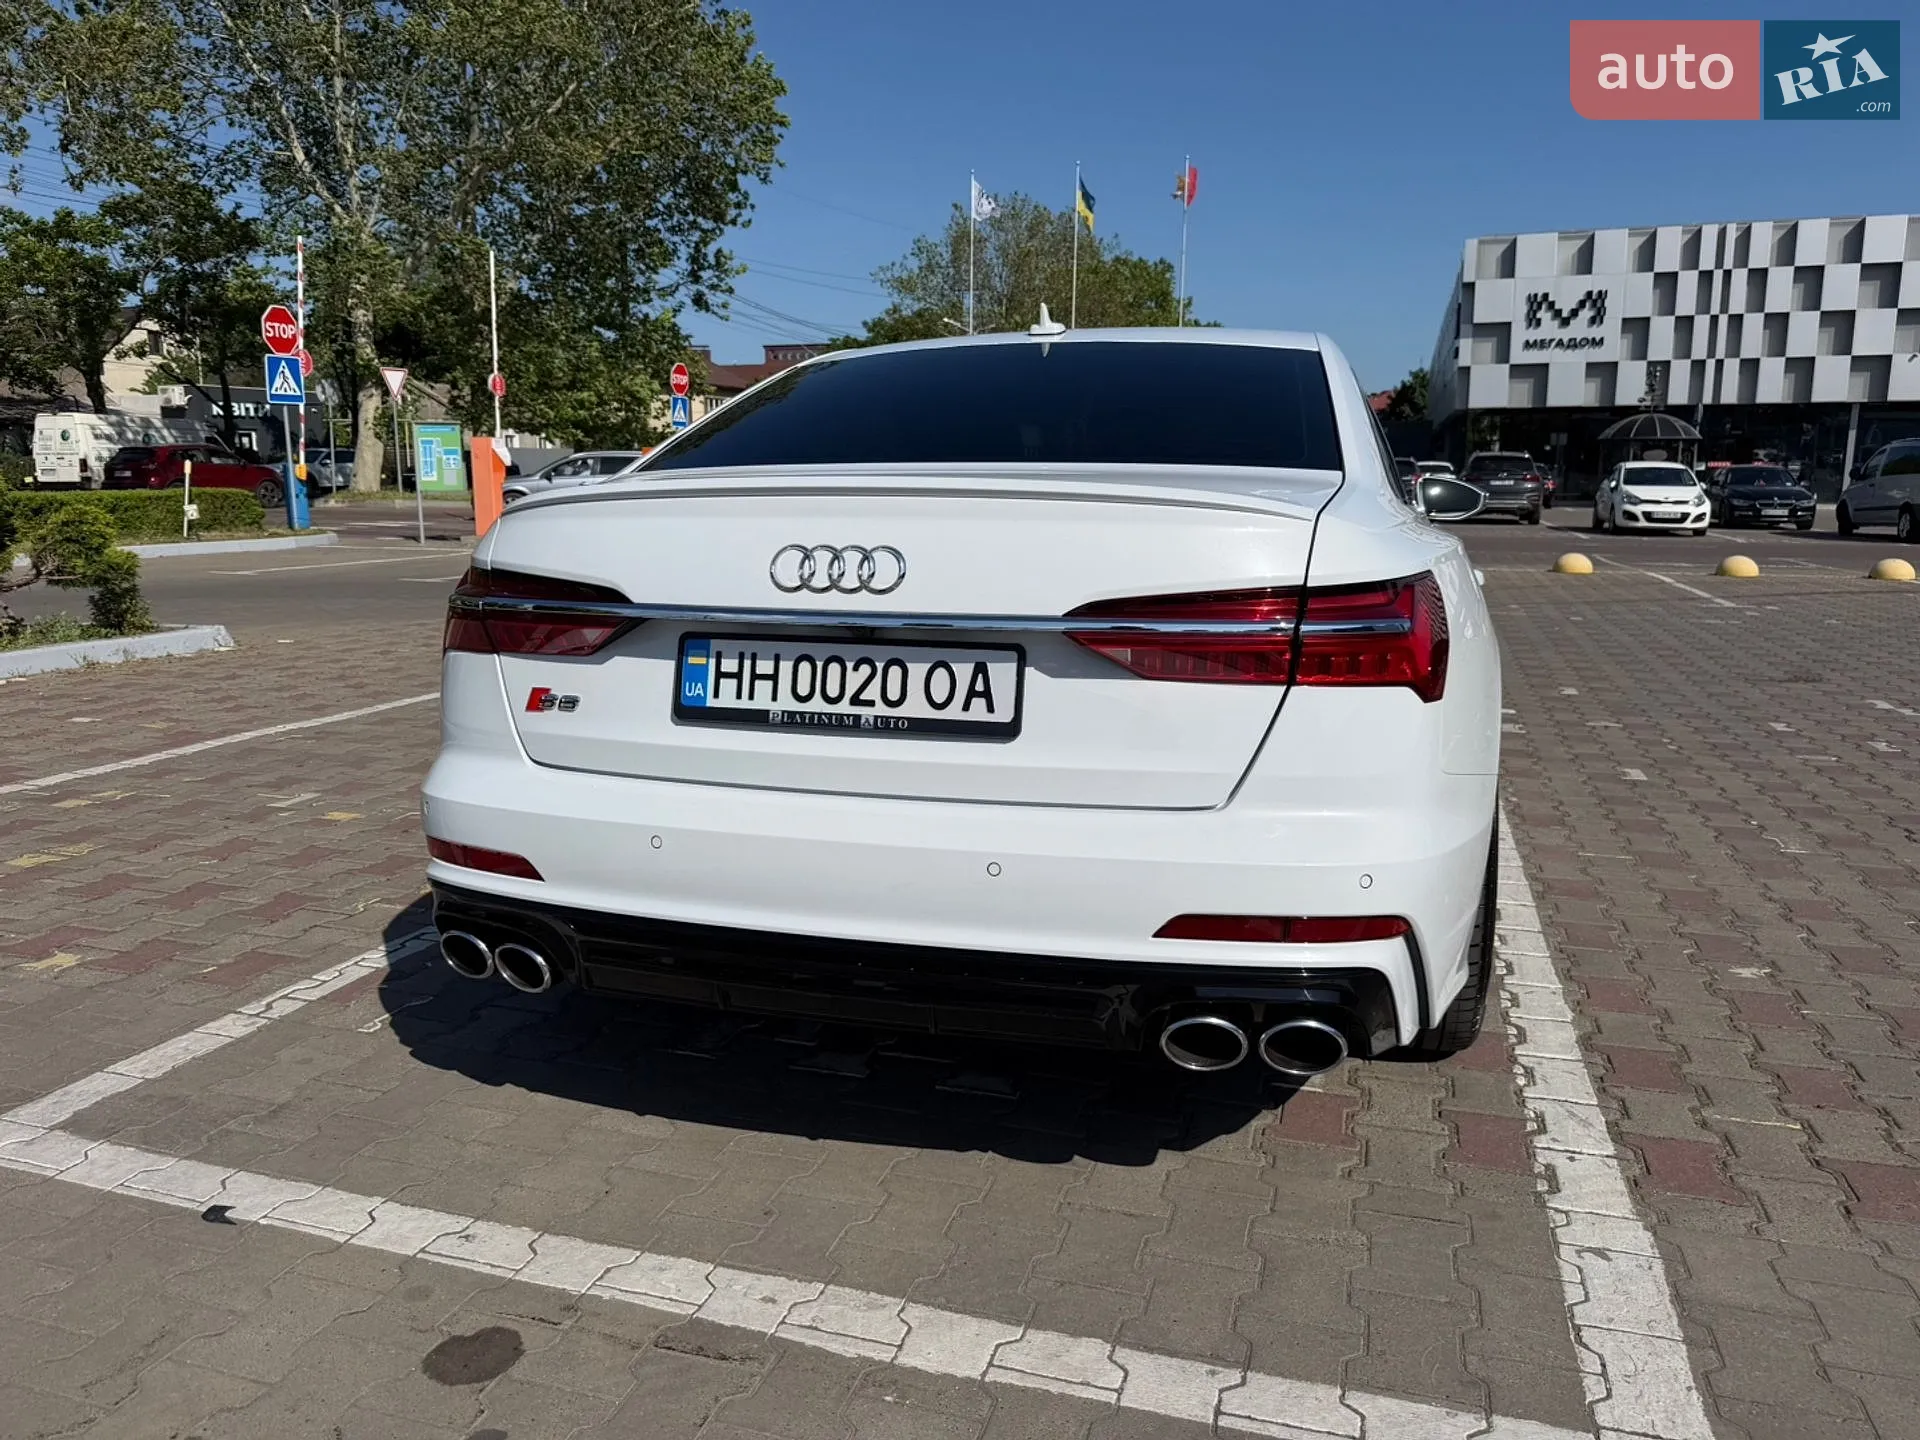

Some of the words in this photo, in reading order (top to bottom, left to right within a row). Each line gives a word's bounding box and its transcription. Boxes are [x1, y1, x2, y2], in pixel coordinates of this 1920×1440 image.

[265, 321, 296, 339] STOP
[1522, 336, 1604, 352] МЕГАДОМ
[672, 373, 689, 385] STOP
[685, 681, 704, 698] UA
